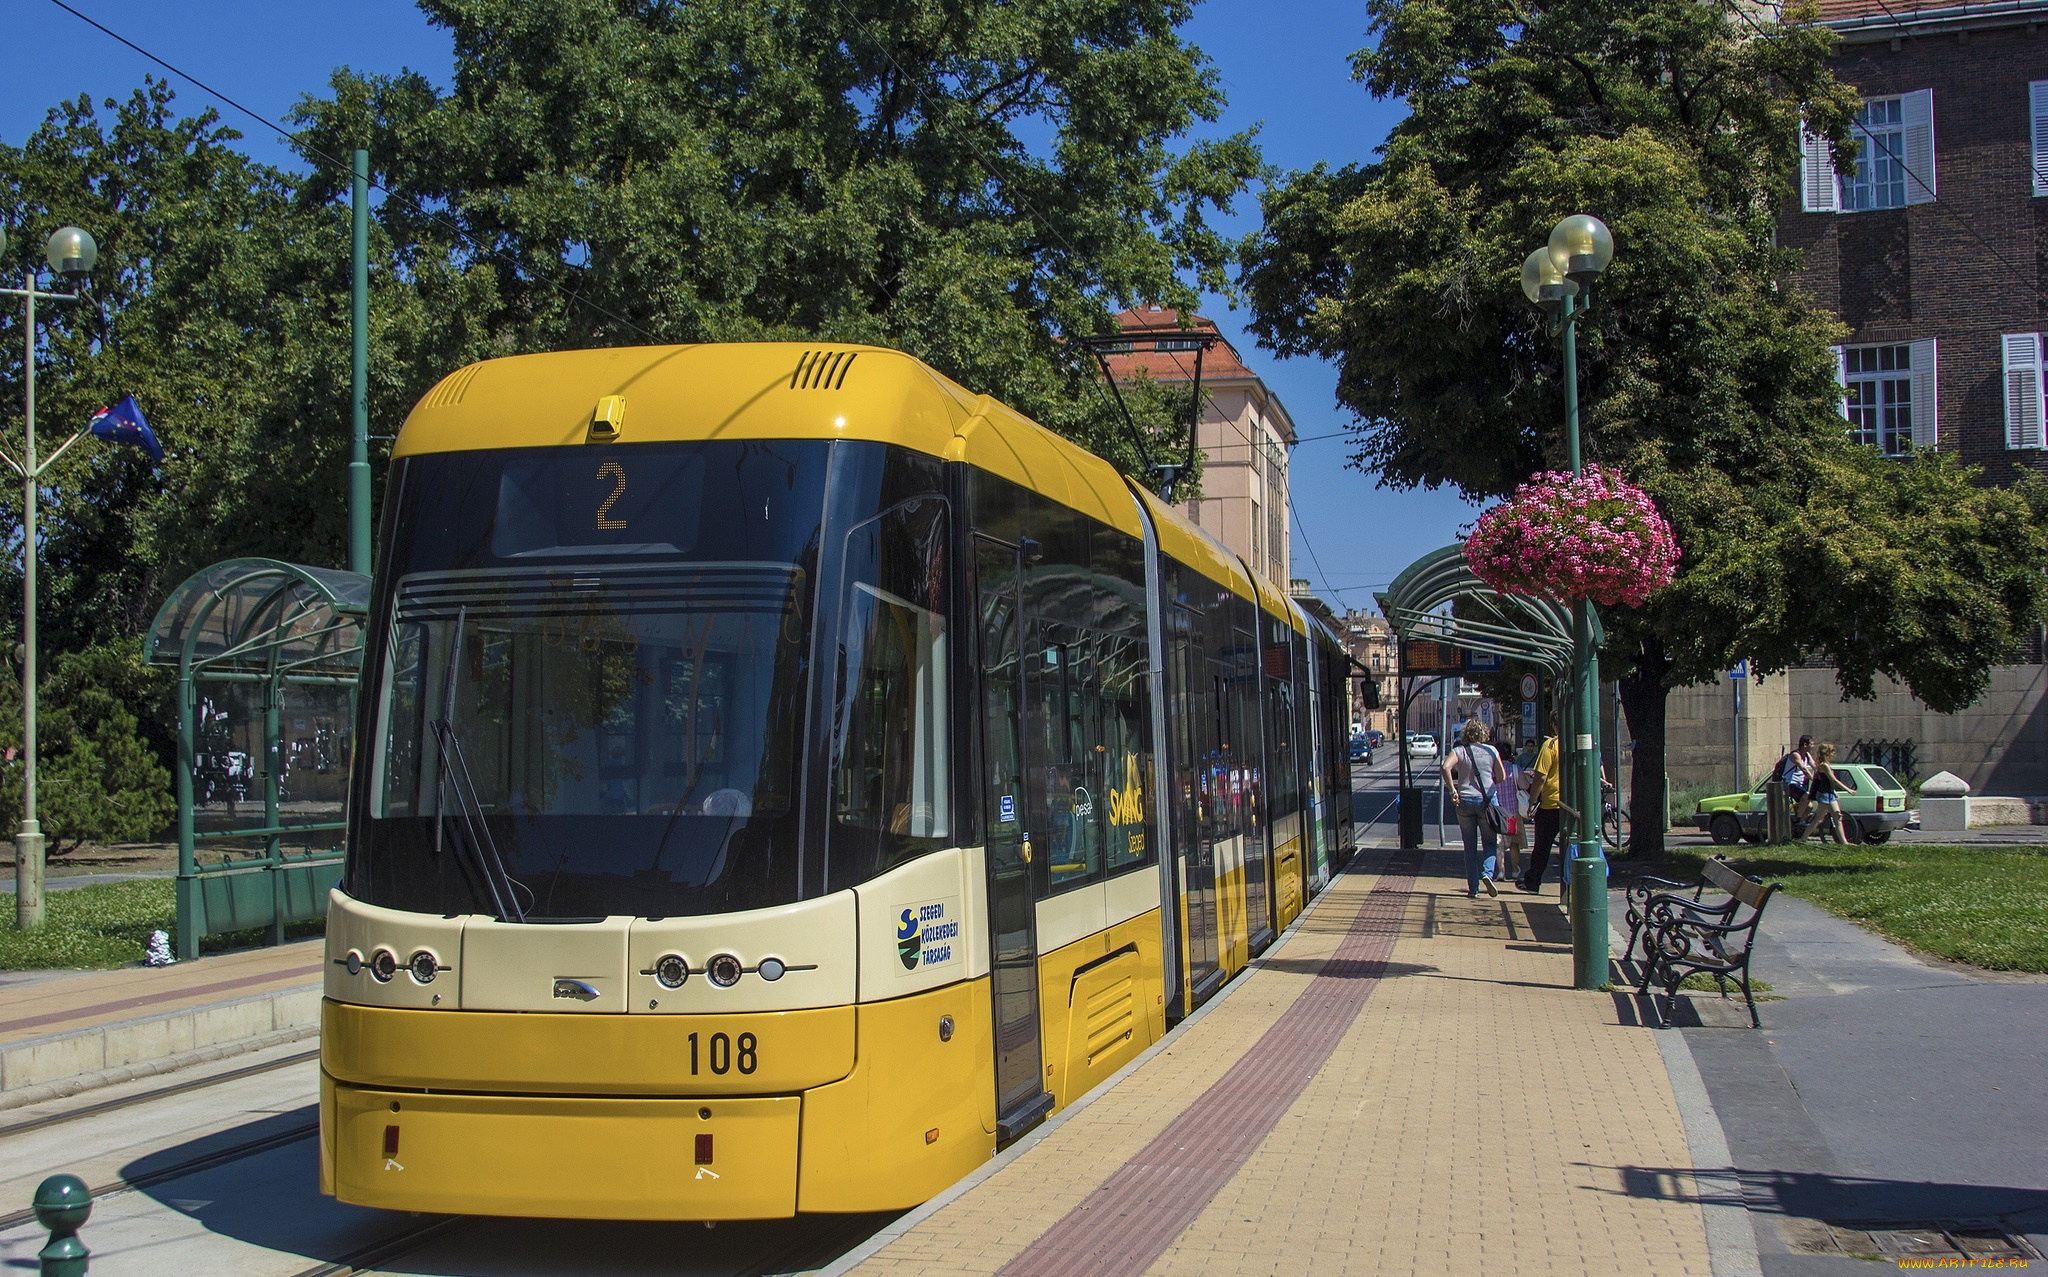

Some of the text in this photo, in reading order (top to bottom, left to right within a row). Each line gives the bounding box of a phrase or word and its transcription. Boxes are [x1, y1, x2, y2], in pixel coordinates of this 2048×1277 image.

[596, 462, 627, 530] 2
[1075, 802, 1093, 821] pesa
[1127, 830, 1145, 857] Szeged
[919, 902, 944, 922] SZEGEDI
[921, 918, 959, 944] KÖZLEKEDÉSI
[922, 941, 951, 966] TÁRSASÁG
[687, 1031, 758, 1076] 108
